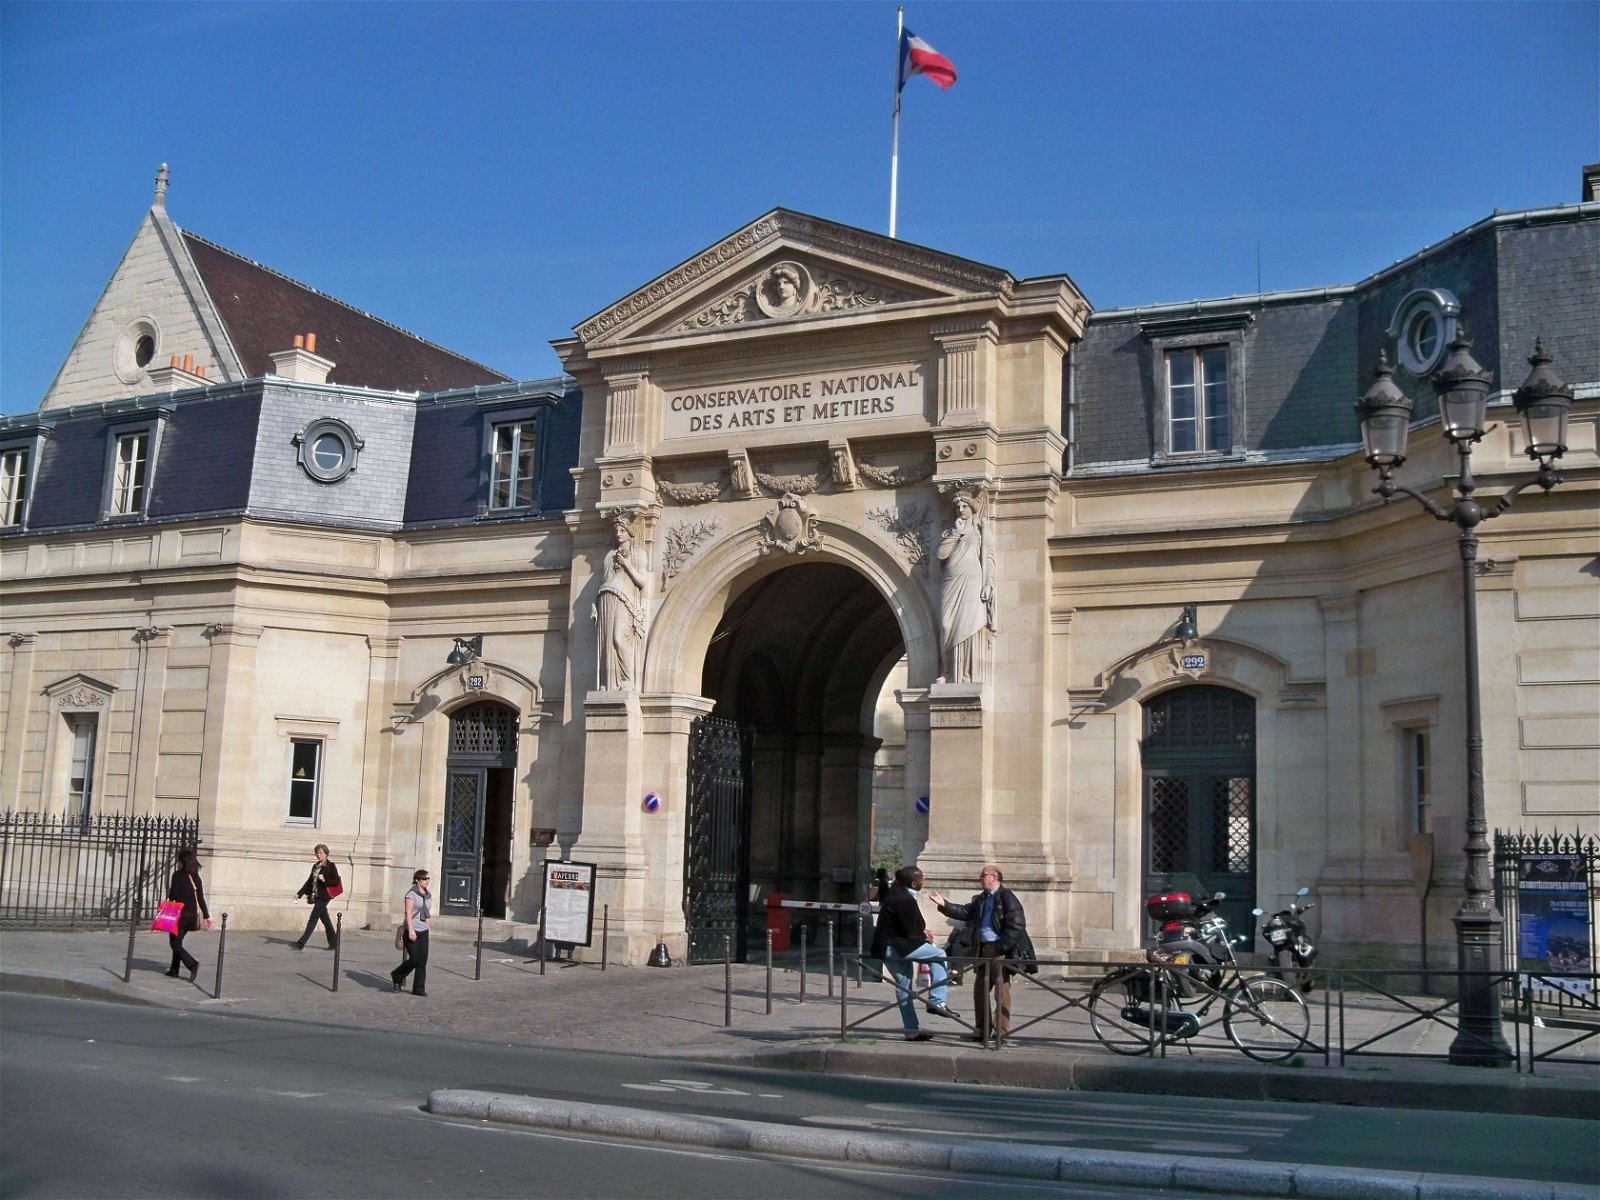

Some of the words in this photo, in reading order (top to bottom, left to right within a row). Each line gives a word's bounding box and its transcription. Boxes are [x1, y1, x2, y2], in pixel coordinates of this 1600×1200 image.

[671, 382, 811, 412] CONSERVATOIRE
[821, 370, 918, 396] NATIONAL
[689, 414, 722, 432] DES
[728, 408, 775, 428] ARTS
[783, 405, 805, 422] ET
[812, 396, 895, 420] METIERS
[1185, 657, 1204, 668] 292
[470, 677, 482, 686] 292
[553, 871, 579, 880] VAPEURS
